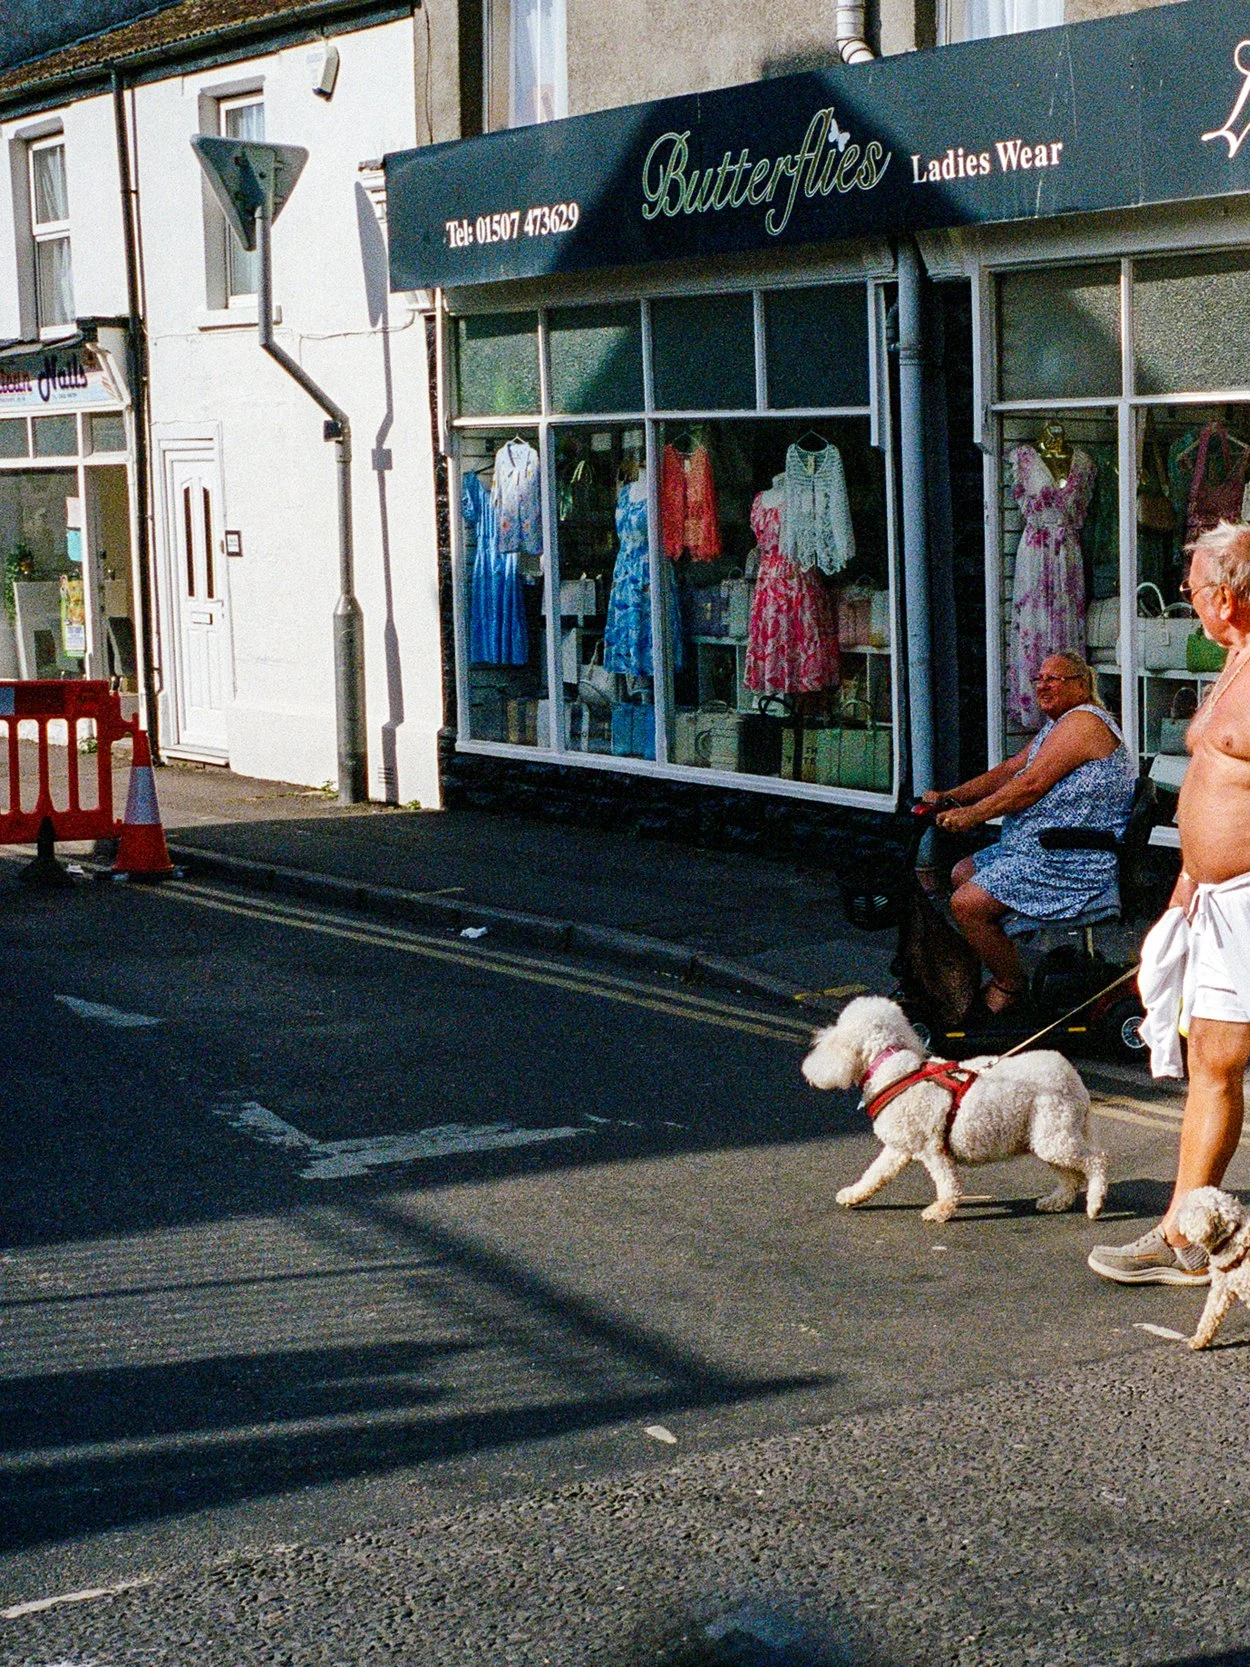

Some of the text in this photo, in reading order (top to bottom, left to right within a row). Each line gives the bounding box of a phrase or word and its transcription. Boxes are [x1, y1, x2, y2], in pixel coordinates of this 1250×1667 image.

[641, 106, 892, 236] Butterflies
[911, 139, 1063, 185] Ladies Wear
[445, 202, 580, 248] Tel: 01507 473629
